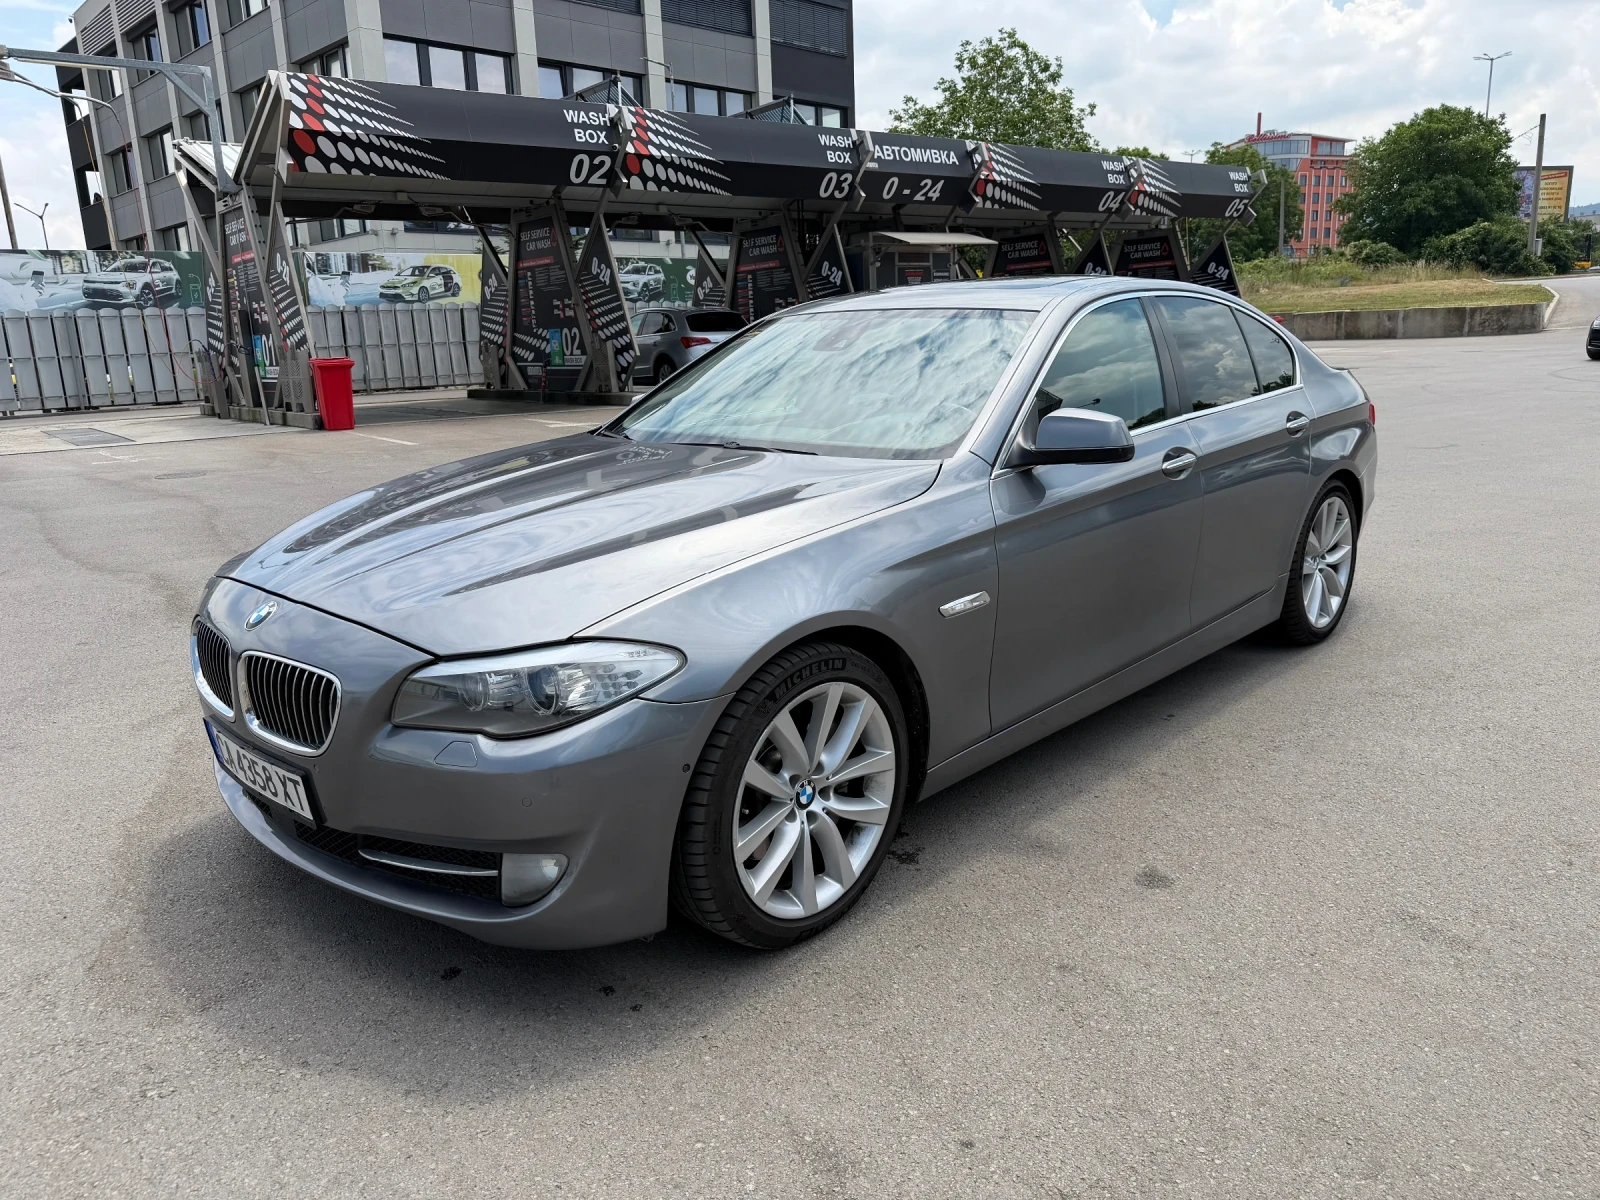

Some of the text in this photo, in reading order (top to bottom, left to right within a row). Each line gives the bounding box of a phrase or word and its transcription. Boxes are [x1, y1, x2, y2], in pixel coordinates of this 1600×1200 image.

[562, 109, 610, 126] WASH
[573, 128, 609, 144] BOX
[817, 134, 853, 148] WASH
[827, 150, 852, 164] BOX
[874, 144, 959, 165] АВТОМИВКА
[569, 153, 612, 184] 02
[1101, 160, 1125, 172] WASH
[819, 171, 852, 199] 03
[1107, 173, 1125, 185] BOX
[1228, 171, 1248, 181] WASH
[882, 176, 899, 199] 0
[913, 178, 944, 201] 24
[1234, 183, 1249, 193] BOX
[1098, 191, 1125, 212] 04
[1225, 198, 1250, 217] 05
[520, 227, 550, 242] SELF SERVICE
[755, 234, 777, 246] SERVICE
[526, 239, 551, 251] CAR WASH
[749, 244, 778, 257] CAR WASH
[1007, 248, 1038, 259] CAR WASH
[1014, 240, 1038, 250] SERVICE
[1124, 242, 1161, 252] SELF SERVICE
[1130, 251, 1142, 259] CAR
[276, 252, 290, 286] 0-24
[591, 256, 611, 286] 0-24
[821, 261, 843, 286] 0-24
[1207, 262, 1229, 281] 0-24
[484, 273, 498, 300] 0-24
[697, 275, 713, 300] 0-24
[261, 333, 276, 366] 01
[561, 326, 581, 356] 02
[775, 659, 844, 700] MICHELIN
[236, 749, 279, 798] 4358
[275, 770, 305, 812] XT
